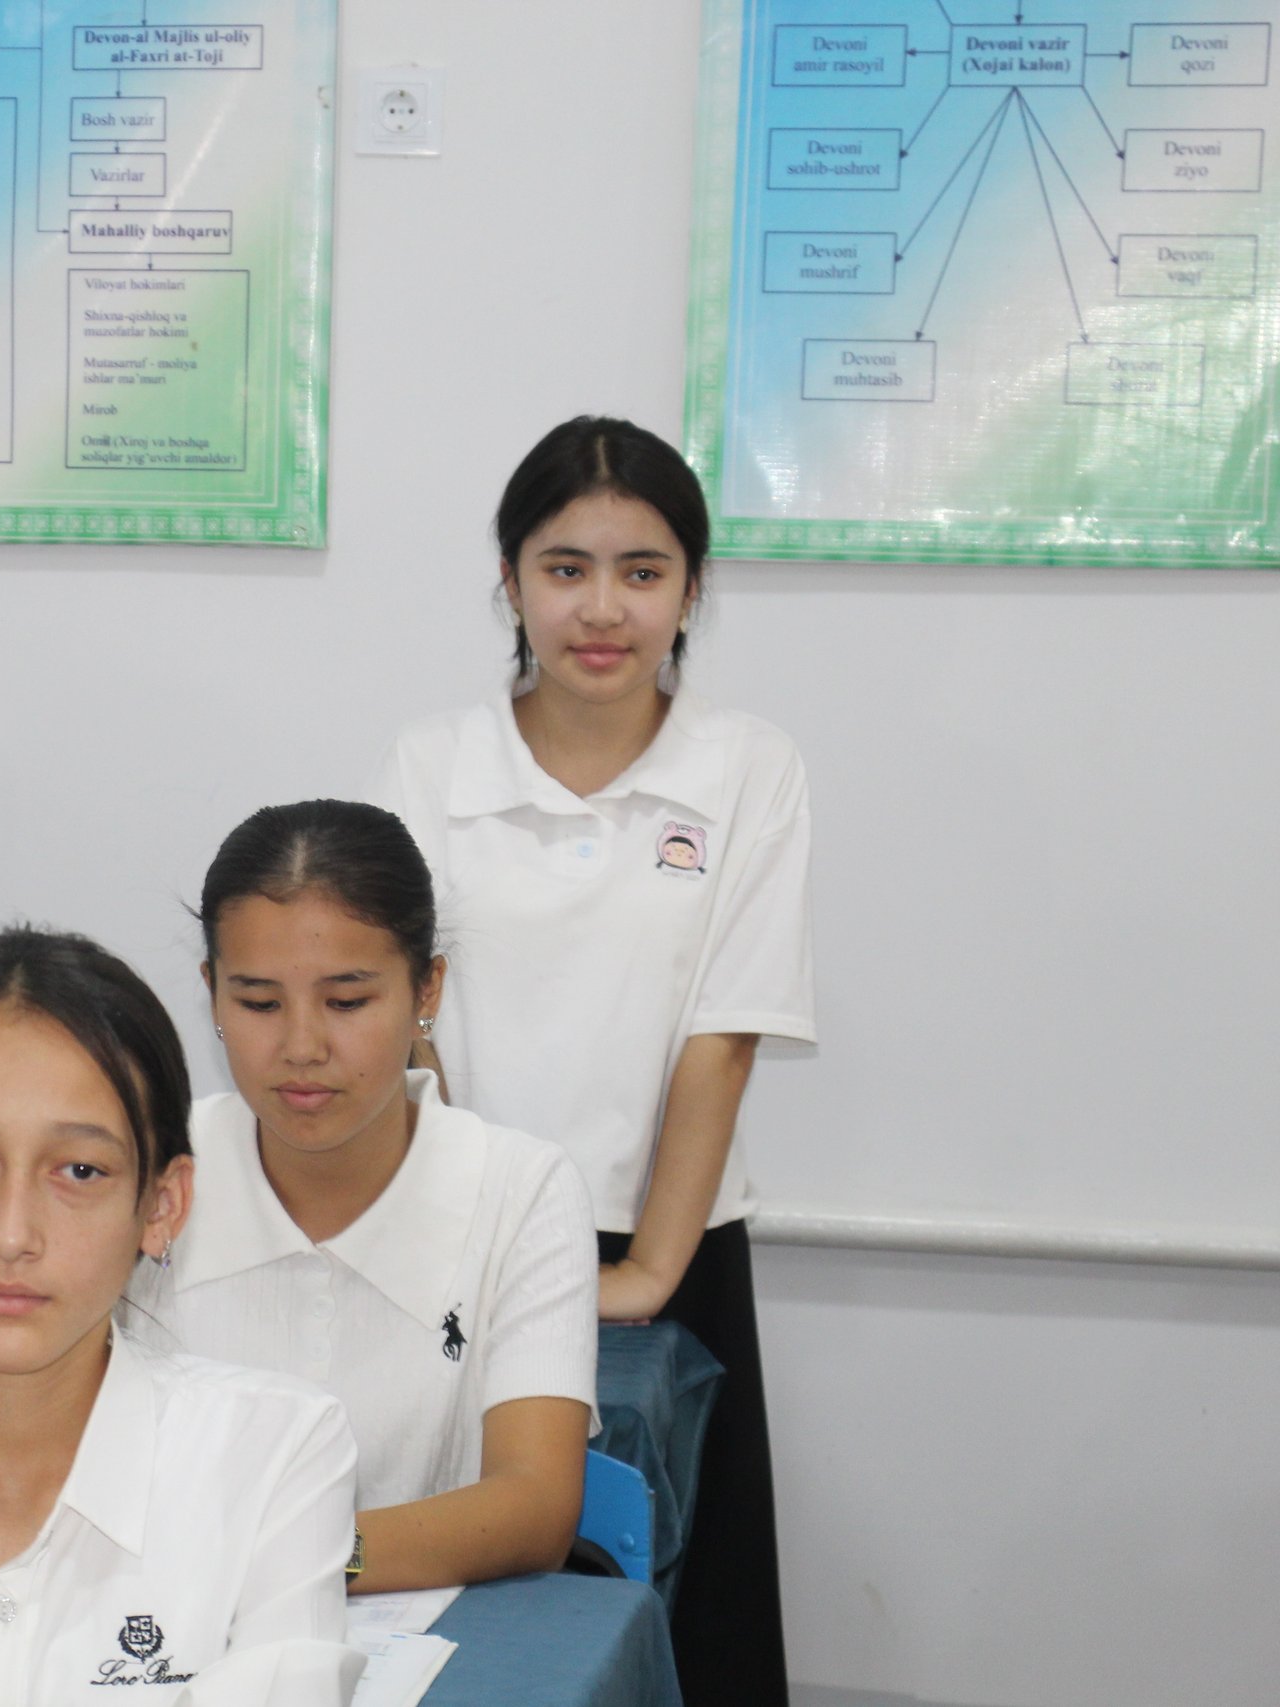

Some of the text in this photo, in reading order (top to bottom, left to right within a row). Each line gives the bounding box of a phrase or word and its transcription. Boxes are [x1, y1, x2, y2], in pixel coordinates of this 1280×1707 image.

[84, 29, 251, 46] Devon-al Majlis ul-oliy
[812, 36, 868, 51] Devoni
[966, 36, 1070, 51] Devoni vazir
[1171, 35, 1228, 50] Devoni
[111, 49, 223, 66] al-Faxri at-Toji
[793, 57, 884, 75] amir rasoyil
[962, 57, 1070, 75] (Xojai kalon)
[1180, 57, 1215, 74] qozi
[82, 113, 155, 126] Bosh vazir
[807, 140, 863, 155] Devoni
[1164, 141, 1222, 156] Devoni
[90, 168, 145, 182] Vazirlar
[1174, 162, 1209, 180] ziyo
[82, 223, 231, 240] Mahalliy boshqaruv
[803, 244, 858, 258] Devoni
[800, 265, 861, 279] mushrif
[841, 351, 897, 366] Devoni
[833, 372, 903, 387] muhtasib
[90, 1659, 142, 1685] Loro
